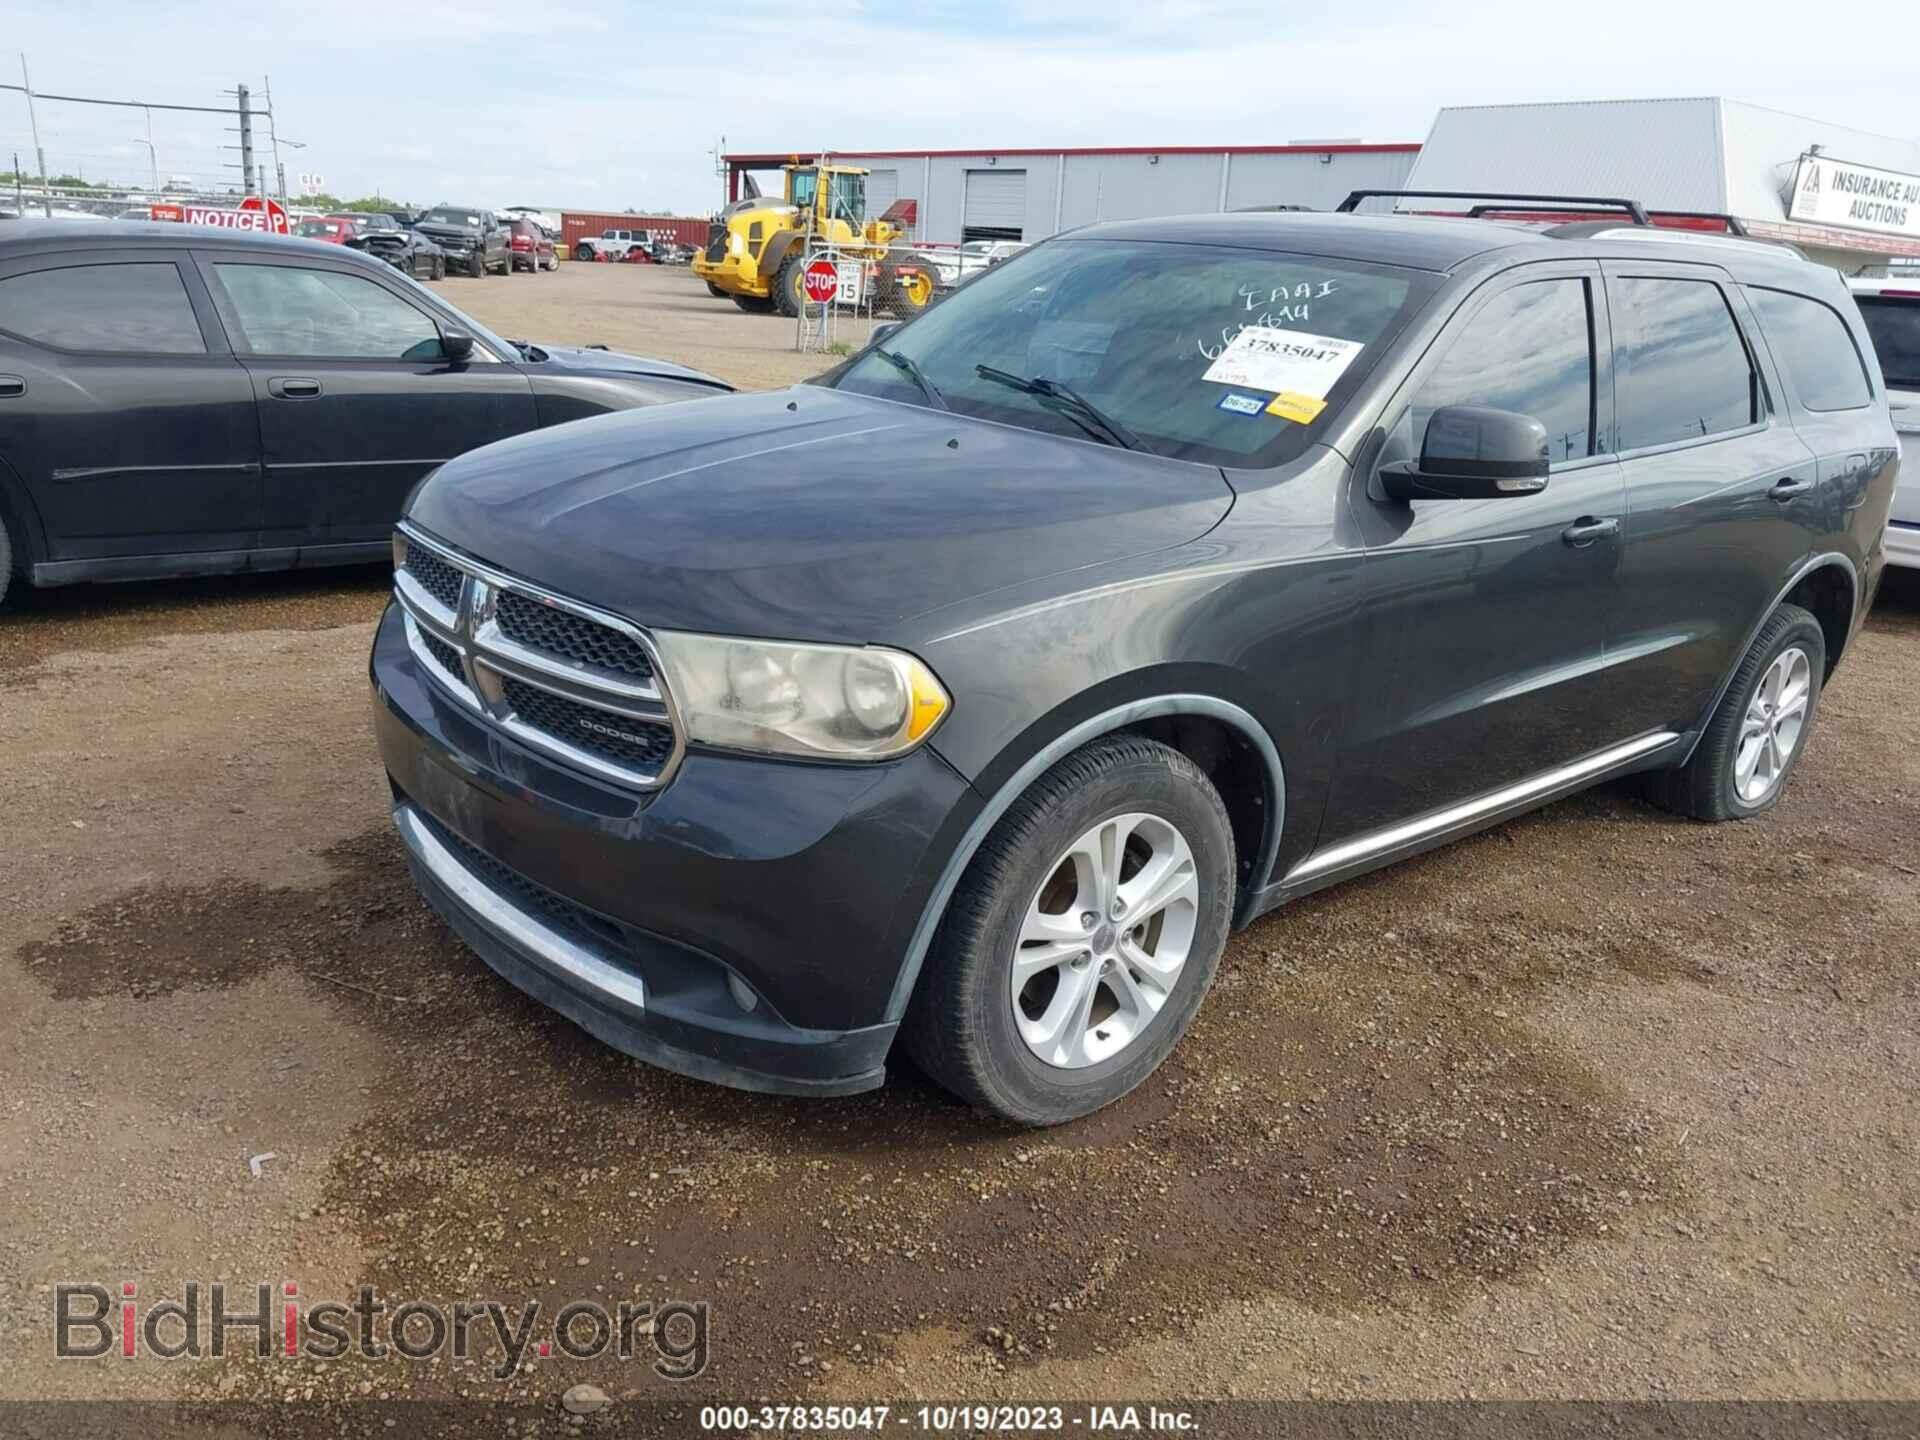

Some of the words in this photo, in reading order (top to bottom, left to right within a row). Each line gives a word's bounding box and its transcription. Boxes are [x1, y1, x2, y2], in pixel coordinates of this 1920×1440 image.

[1832, 170, 1902, 201] INSURANCE
[1901, 184, 1920, 205] AU
[190, 210, 265, 232] NOTICE
[1848, 200, 1908, 226] AUCTIONS
[806, 272, 836, 291] STOP
[840, 284, 856, 299] 15
[1242, 338, 1340, 363] 37835047
[580, 719, 649, 747] DODGE
